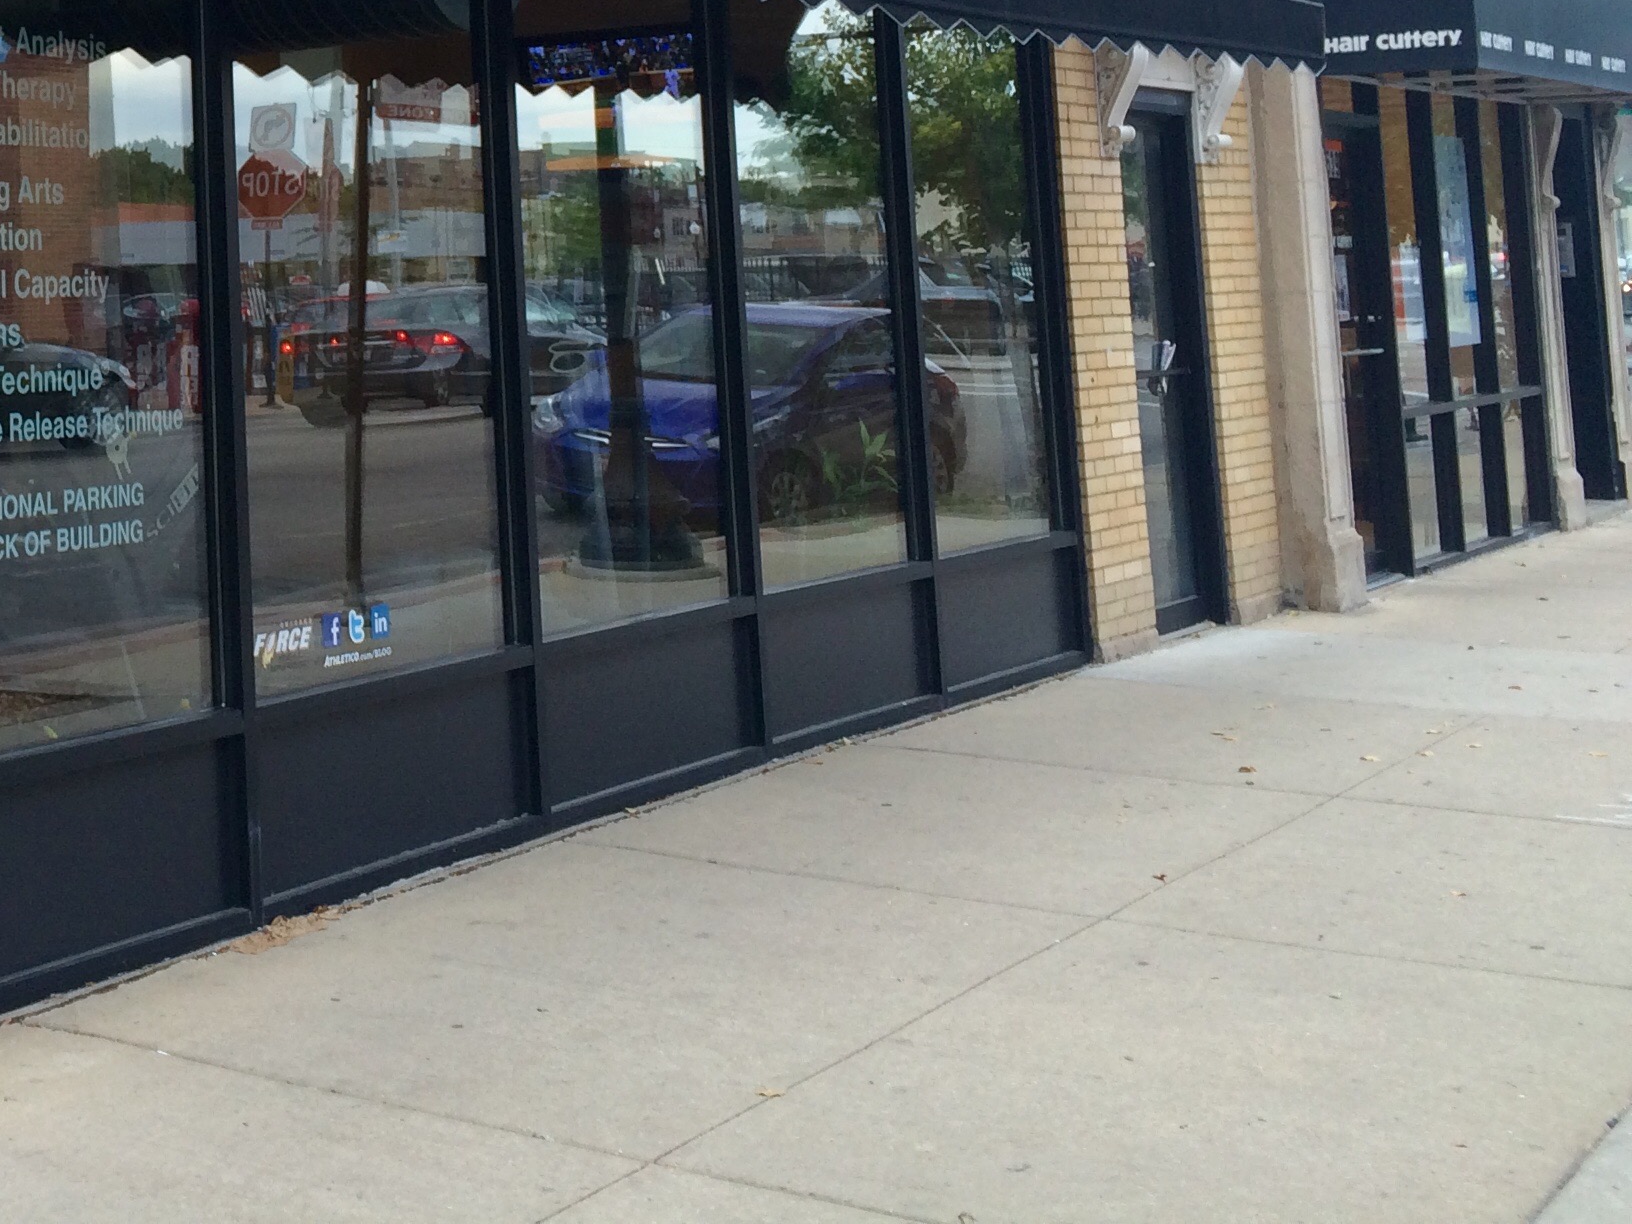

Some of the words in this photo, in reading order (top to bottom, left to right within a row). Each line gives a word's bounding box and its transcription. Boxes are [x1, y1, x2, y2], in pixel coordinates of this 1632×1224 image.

[16, 27, 107, 61] Analysis
[1324, 34, 1369, 54] Hair
[18, 176, 64, 205] Arts
[14, 268, 109, 305] Capacity
[9, 409, 87, 443] Release
[92, 404, 184, 436] Technique
[64, 482, 144, 513] PARKING
[24, 531, 51, 556] OF
[57, 519, 144, 552] BUILDING
